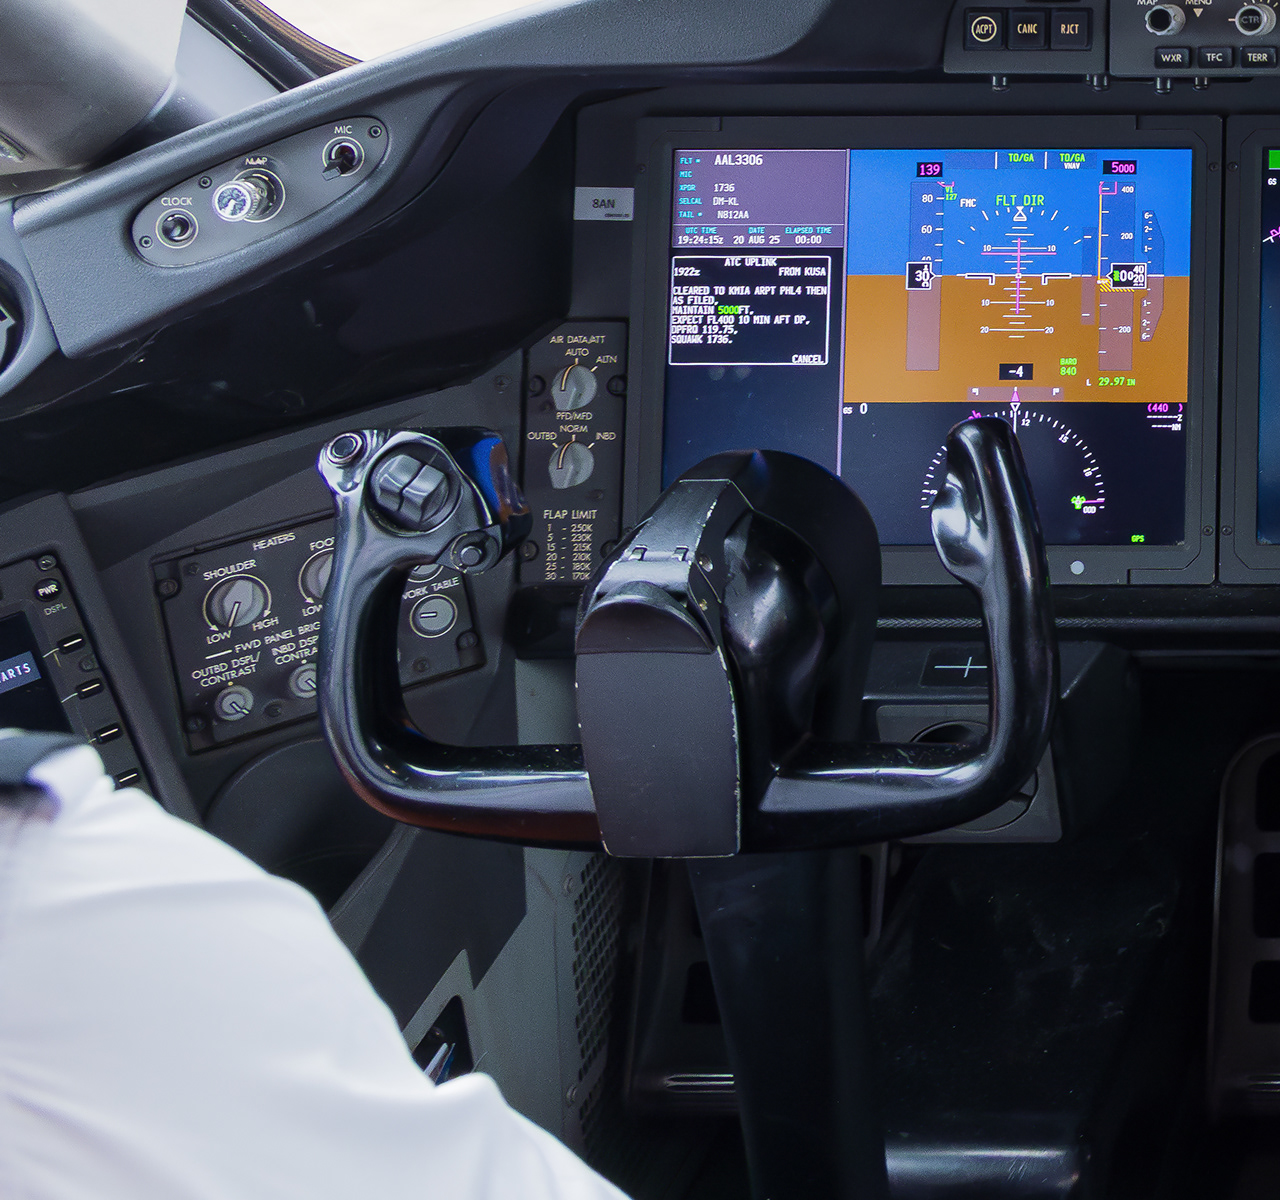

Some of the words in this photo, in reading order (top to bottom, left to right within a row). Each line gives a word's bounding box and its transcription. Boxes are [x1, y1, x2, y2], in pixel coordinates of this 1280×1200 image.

[975, 24, 993, 35] ACPT
[1018, 24, 1037, 33] CANC
[1061, 24, 1078, 34] RJCT
[1161, 54, 1182, 62] WXR
[1248, 53, 1267, 61] TERR
[334, 126, 352, 134] MIC
[715, 154, 763, 165] AAL3306
[161, 196, 192, 206] CLOCK
[713, 197, 739, 205] DM-KL
[996, 196, 1019, 206] FLT
[1023, 195, 1044, 206] DIR
[718, 211, 749, 219] N812AA
[677, 233, 723, 245] 19:24:15z
[733, 236, 744, 244] 20
[748, 236, 765, 244] AUG
[769, 235, 780, 244] 25
[725, 258, 741, 266] ATC
[745, 258, 777, 266] UPLINK
[779, 268, 801, 276] FROM
[804, 268, 826, 276] KUSA
[672, 316, 702, 324] EXPECT
[707, 316, 734, 324] FL400
[739, 315, 750, 324] 10
[753, 315, 770, 324] MIN
[774, 315, 791, 324] AFT
[792, 355, 823, 363] CANCEL
[544, 510, 567, 519] FLAP
[572, 510, 597, 519] LIMIT
[252, 532, 296, 551] HEATERS
[203, 560, 257, 581] SHOULDER
